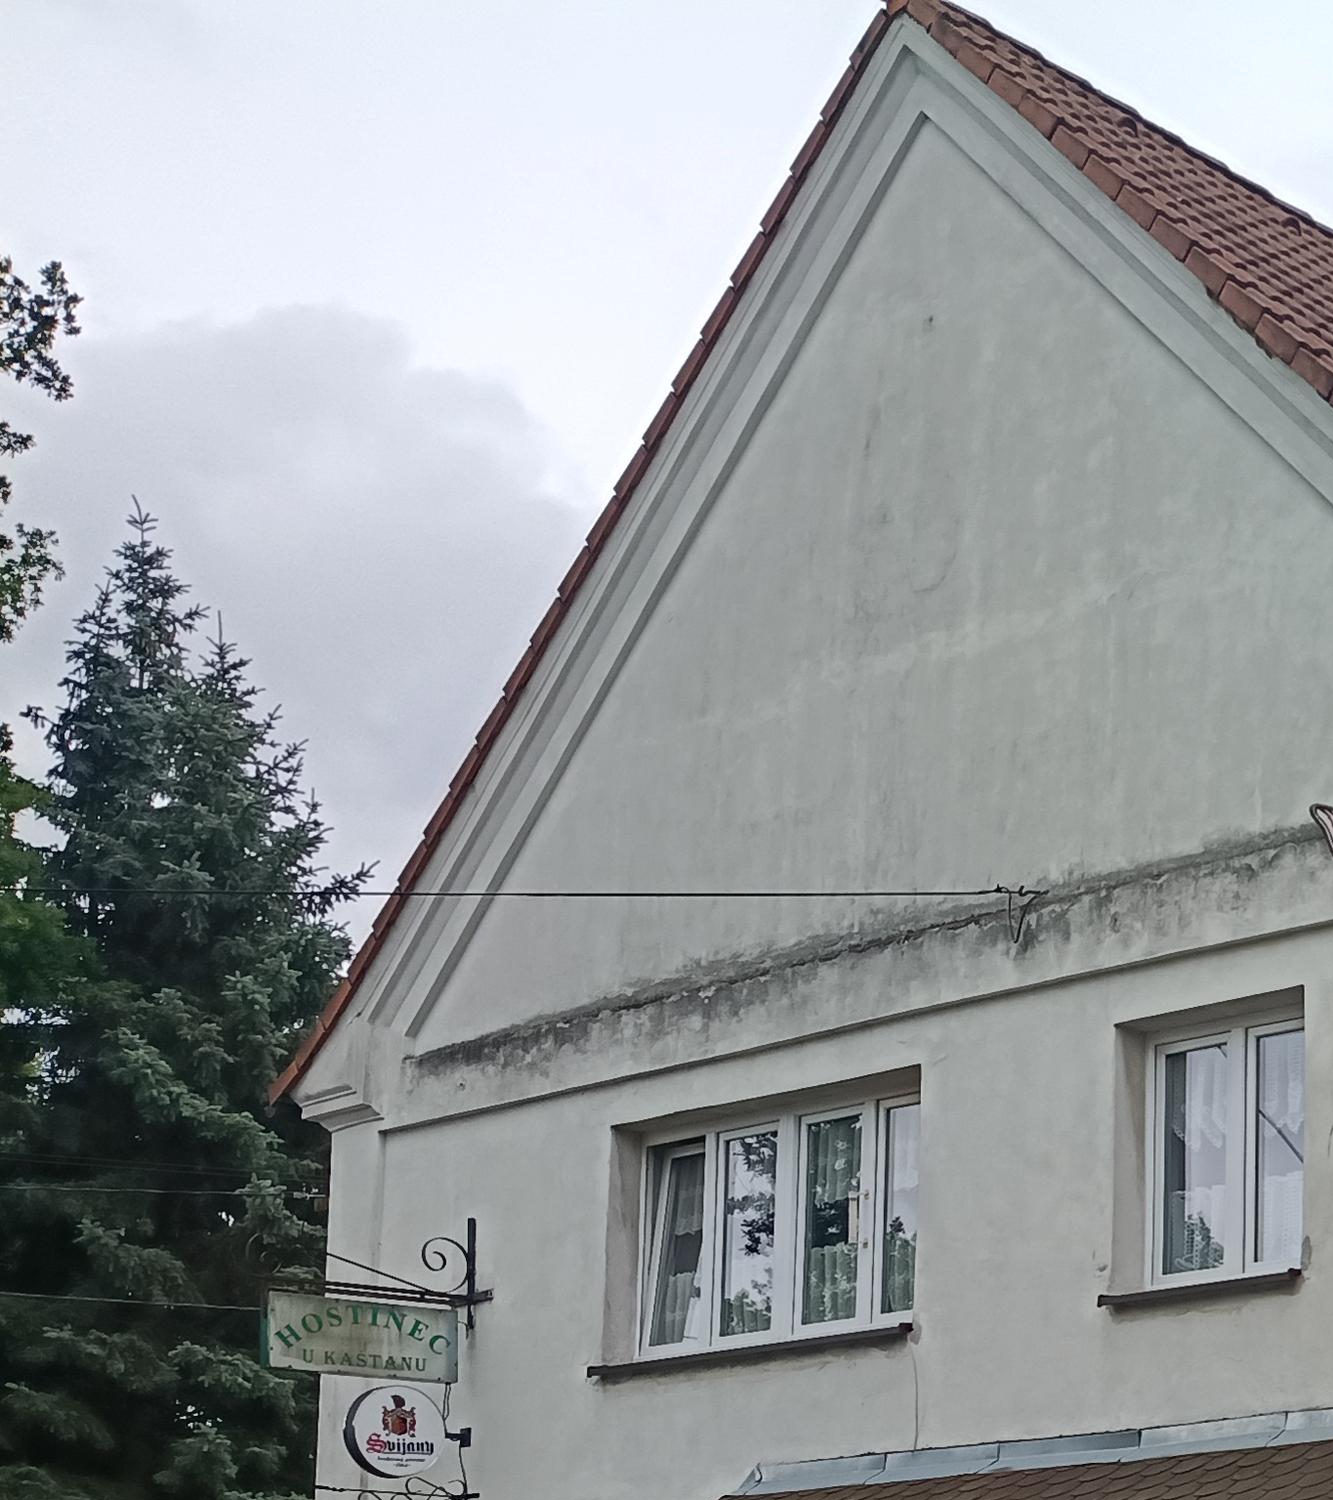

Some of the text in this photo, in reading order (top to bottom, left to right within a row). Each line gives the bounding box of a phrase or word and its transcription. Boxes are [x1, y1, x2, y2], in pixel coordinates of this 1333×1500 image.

[274, 1304, 451, 1356] HOSTINEC
[302, 1348, 315, 1364] U
[366, 1432, 434, 1456] Svijany
